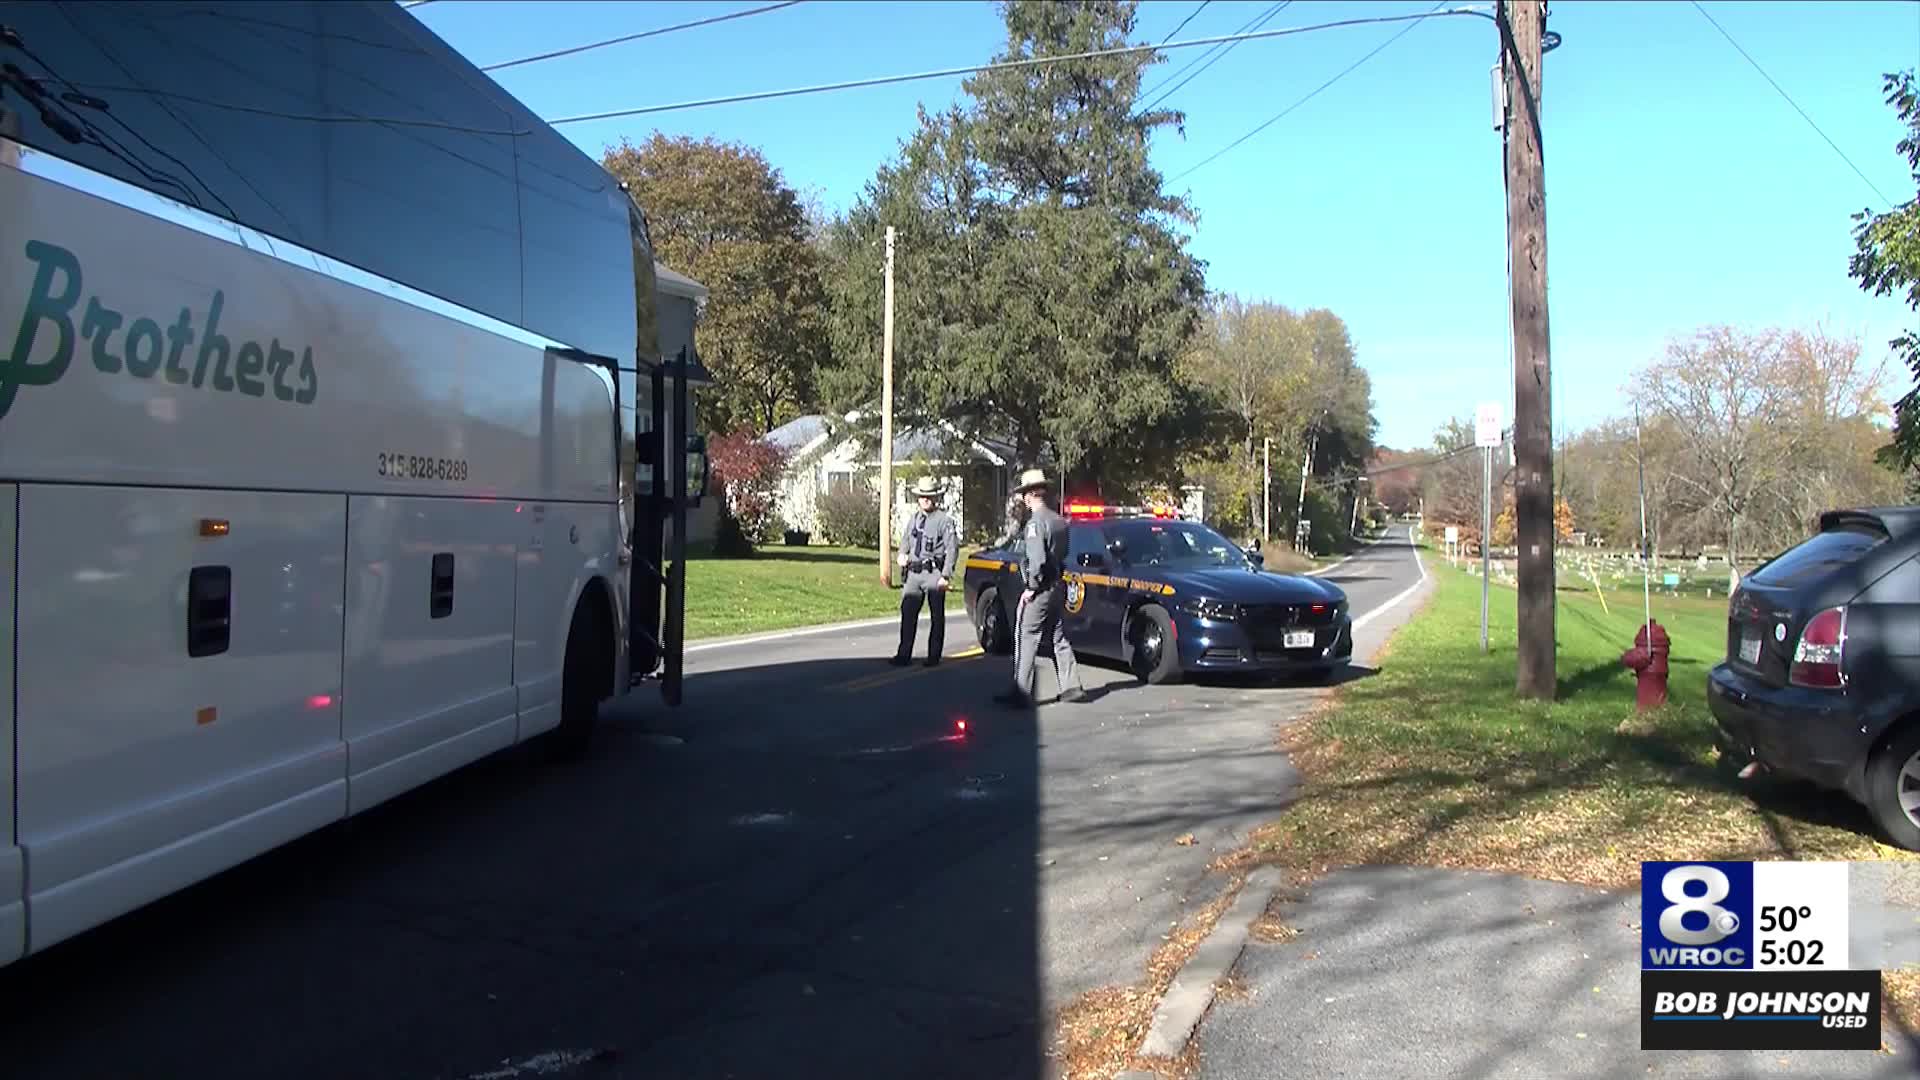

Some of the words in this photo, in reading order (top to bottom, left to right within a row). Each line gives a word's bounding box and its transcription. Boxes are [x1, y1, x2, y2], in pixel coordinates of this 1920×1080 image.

[0, 239, 318, 418] Brothers
[378, 452, 468, 481] 315-828-6289
[1109, 576, 1130, 589] STATE
[1130, 579, 1163, 593] TROOPER
